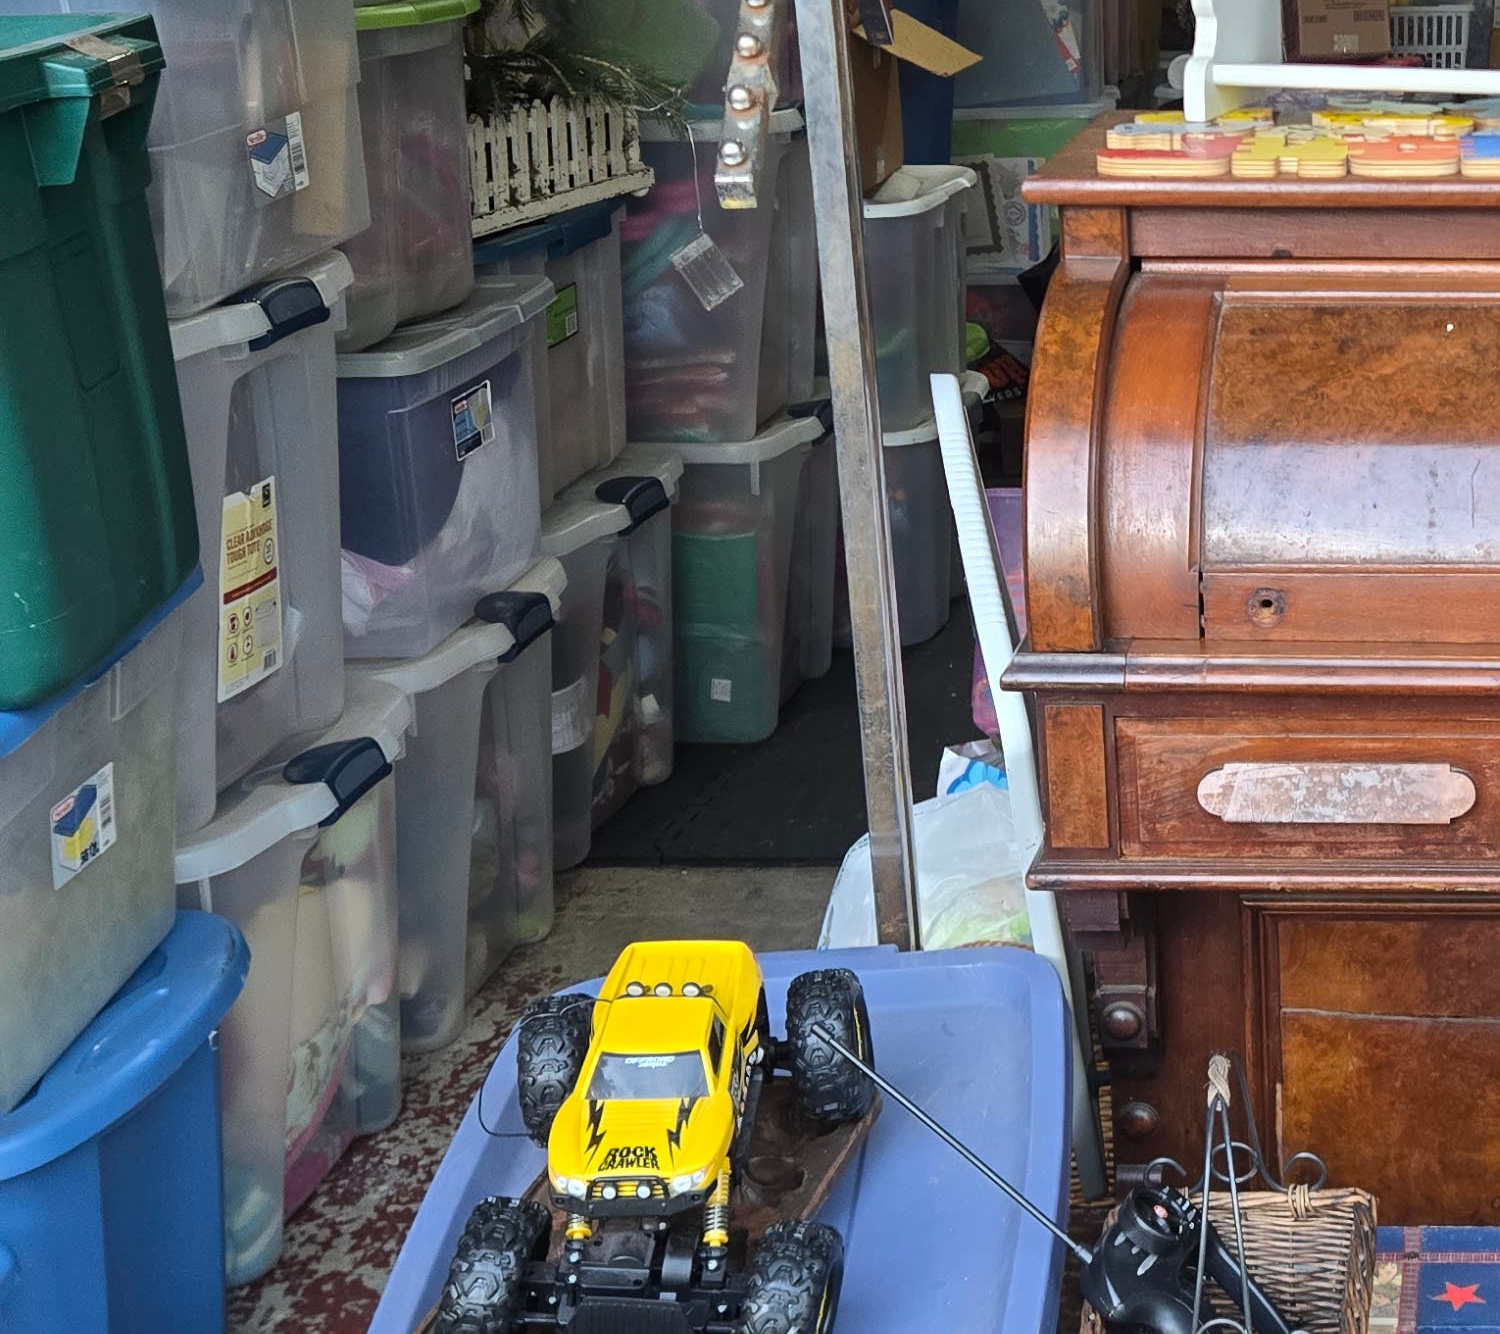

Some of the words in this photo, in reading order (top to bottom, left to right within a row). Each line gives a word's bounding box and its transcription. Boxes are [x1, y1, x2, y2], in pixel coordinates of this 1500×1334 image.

[226, 532, 245, 551] CLEAR
[226, 546, 246, 565] TOUGH
[604, 1146, 657, 1162] ROCK
[598, 1157, 660, 1171] CRAWLER
